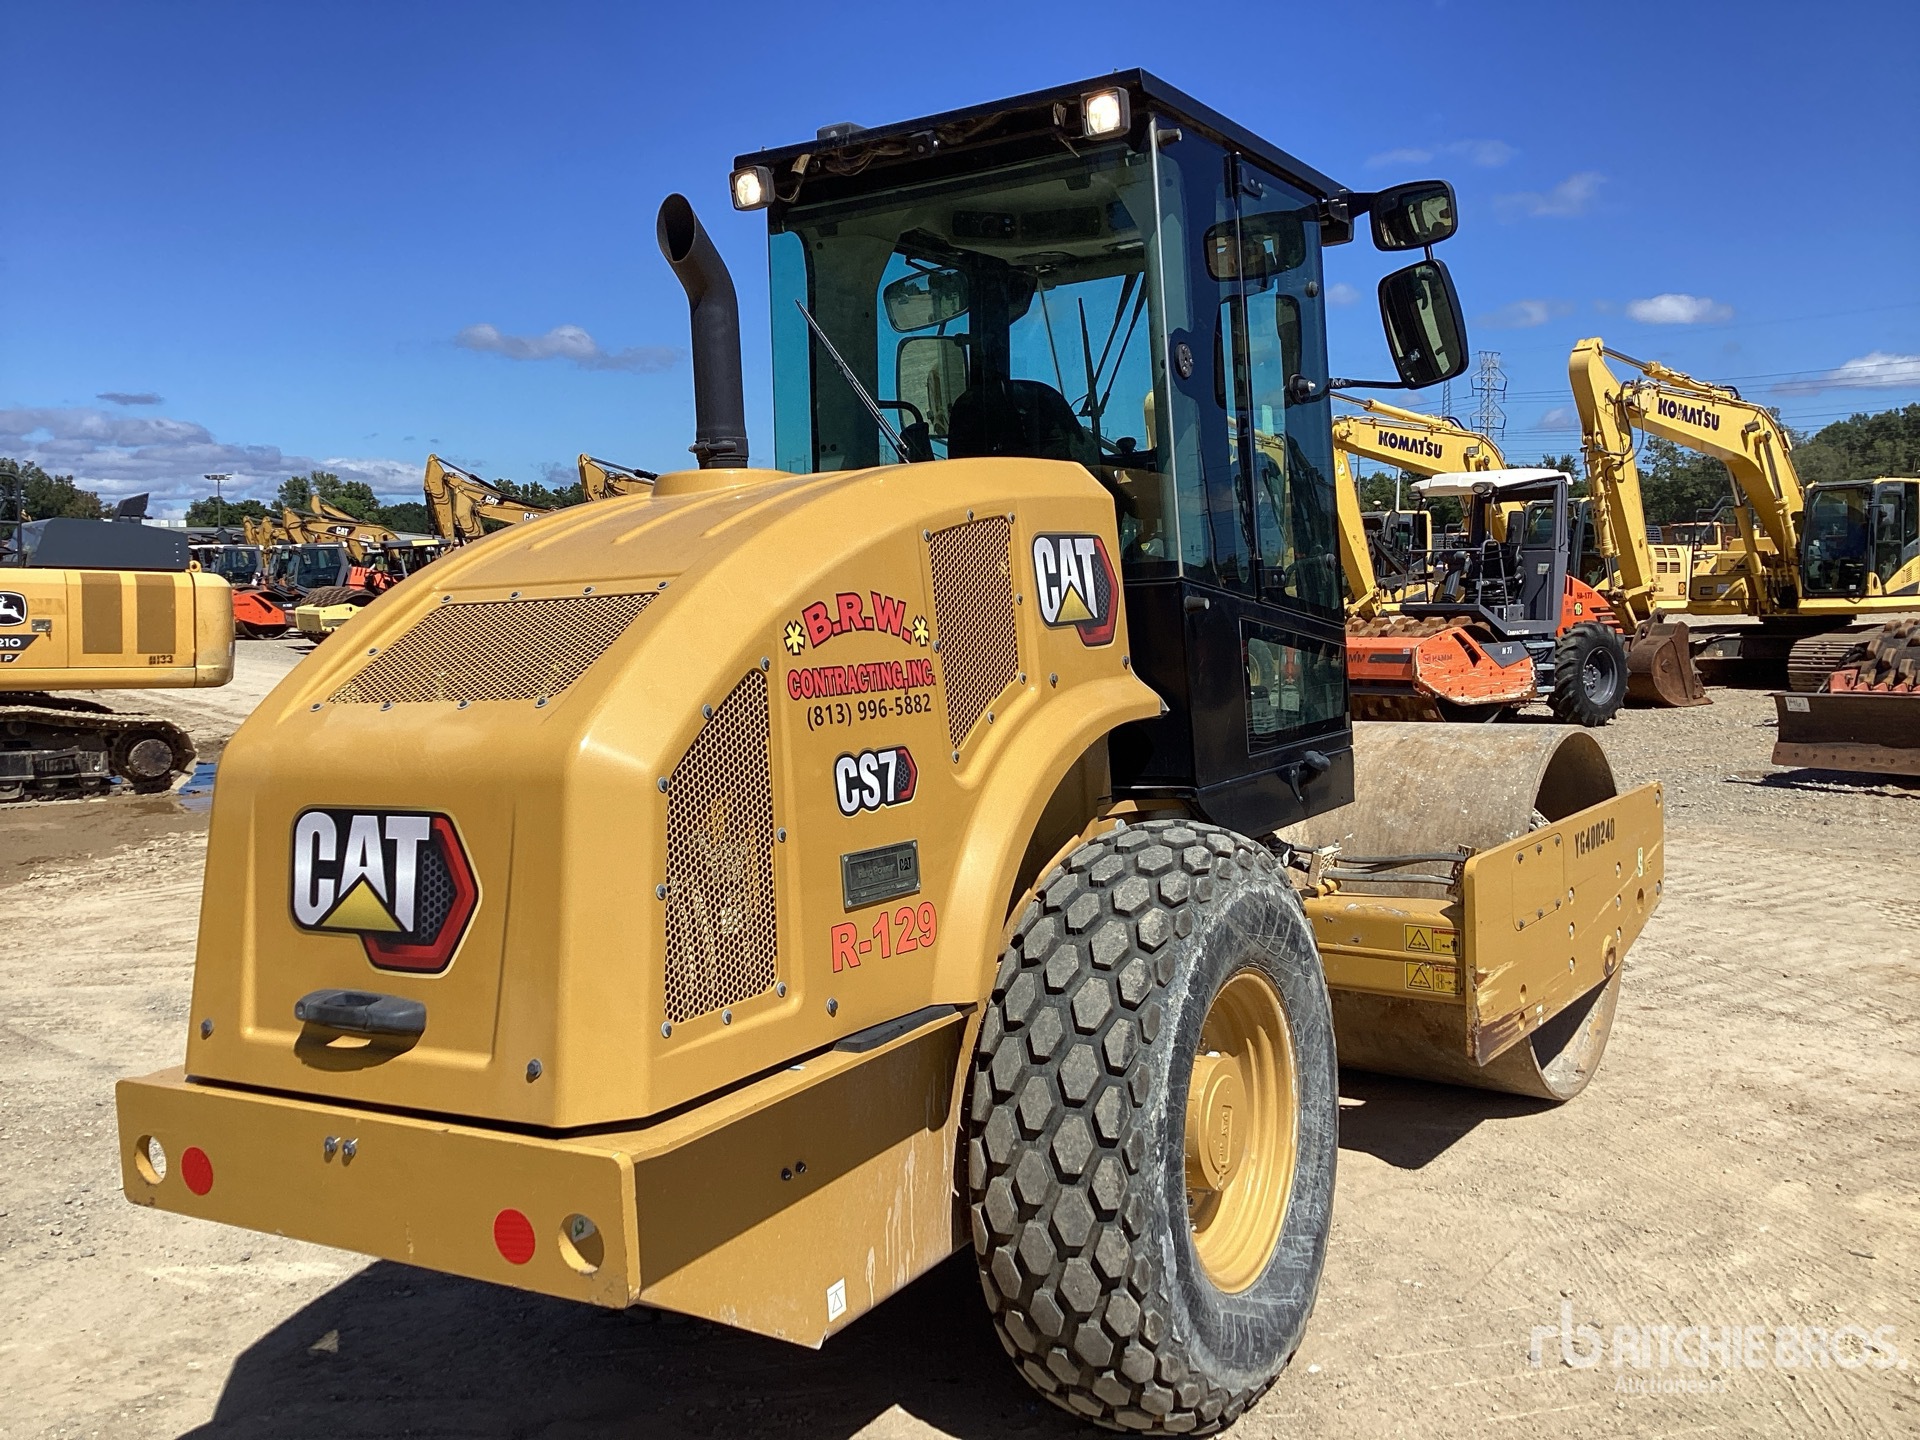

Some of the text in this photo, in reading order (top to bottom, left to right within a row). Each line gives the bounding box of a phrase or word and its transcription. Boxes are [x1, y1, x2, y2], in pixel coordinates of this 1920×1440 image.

[1658, 397, 1720, 431] KOMATSU
[1378, 430, 1443, 459] KOMATSU
[485, 495, 499, 505] CAT
[336, 526, 350, 536] CAT
[1033, 537, 1098, 623] CAT
[801, 589, 912, 649] B.R.W.
[807, 693, 932, 732] (813) 996-5882
[836, 750, 897, 813] CS7
[1574, 817, 1615, 860] YG400240
[293, 811, 431, 933] CAT
[899, 856, 912, 871] CAT
[831, 901, 938, 974] R-129
